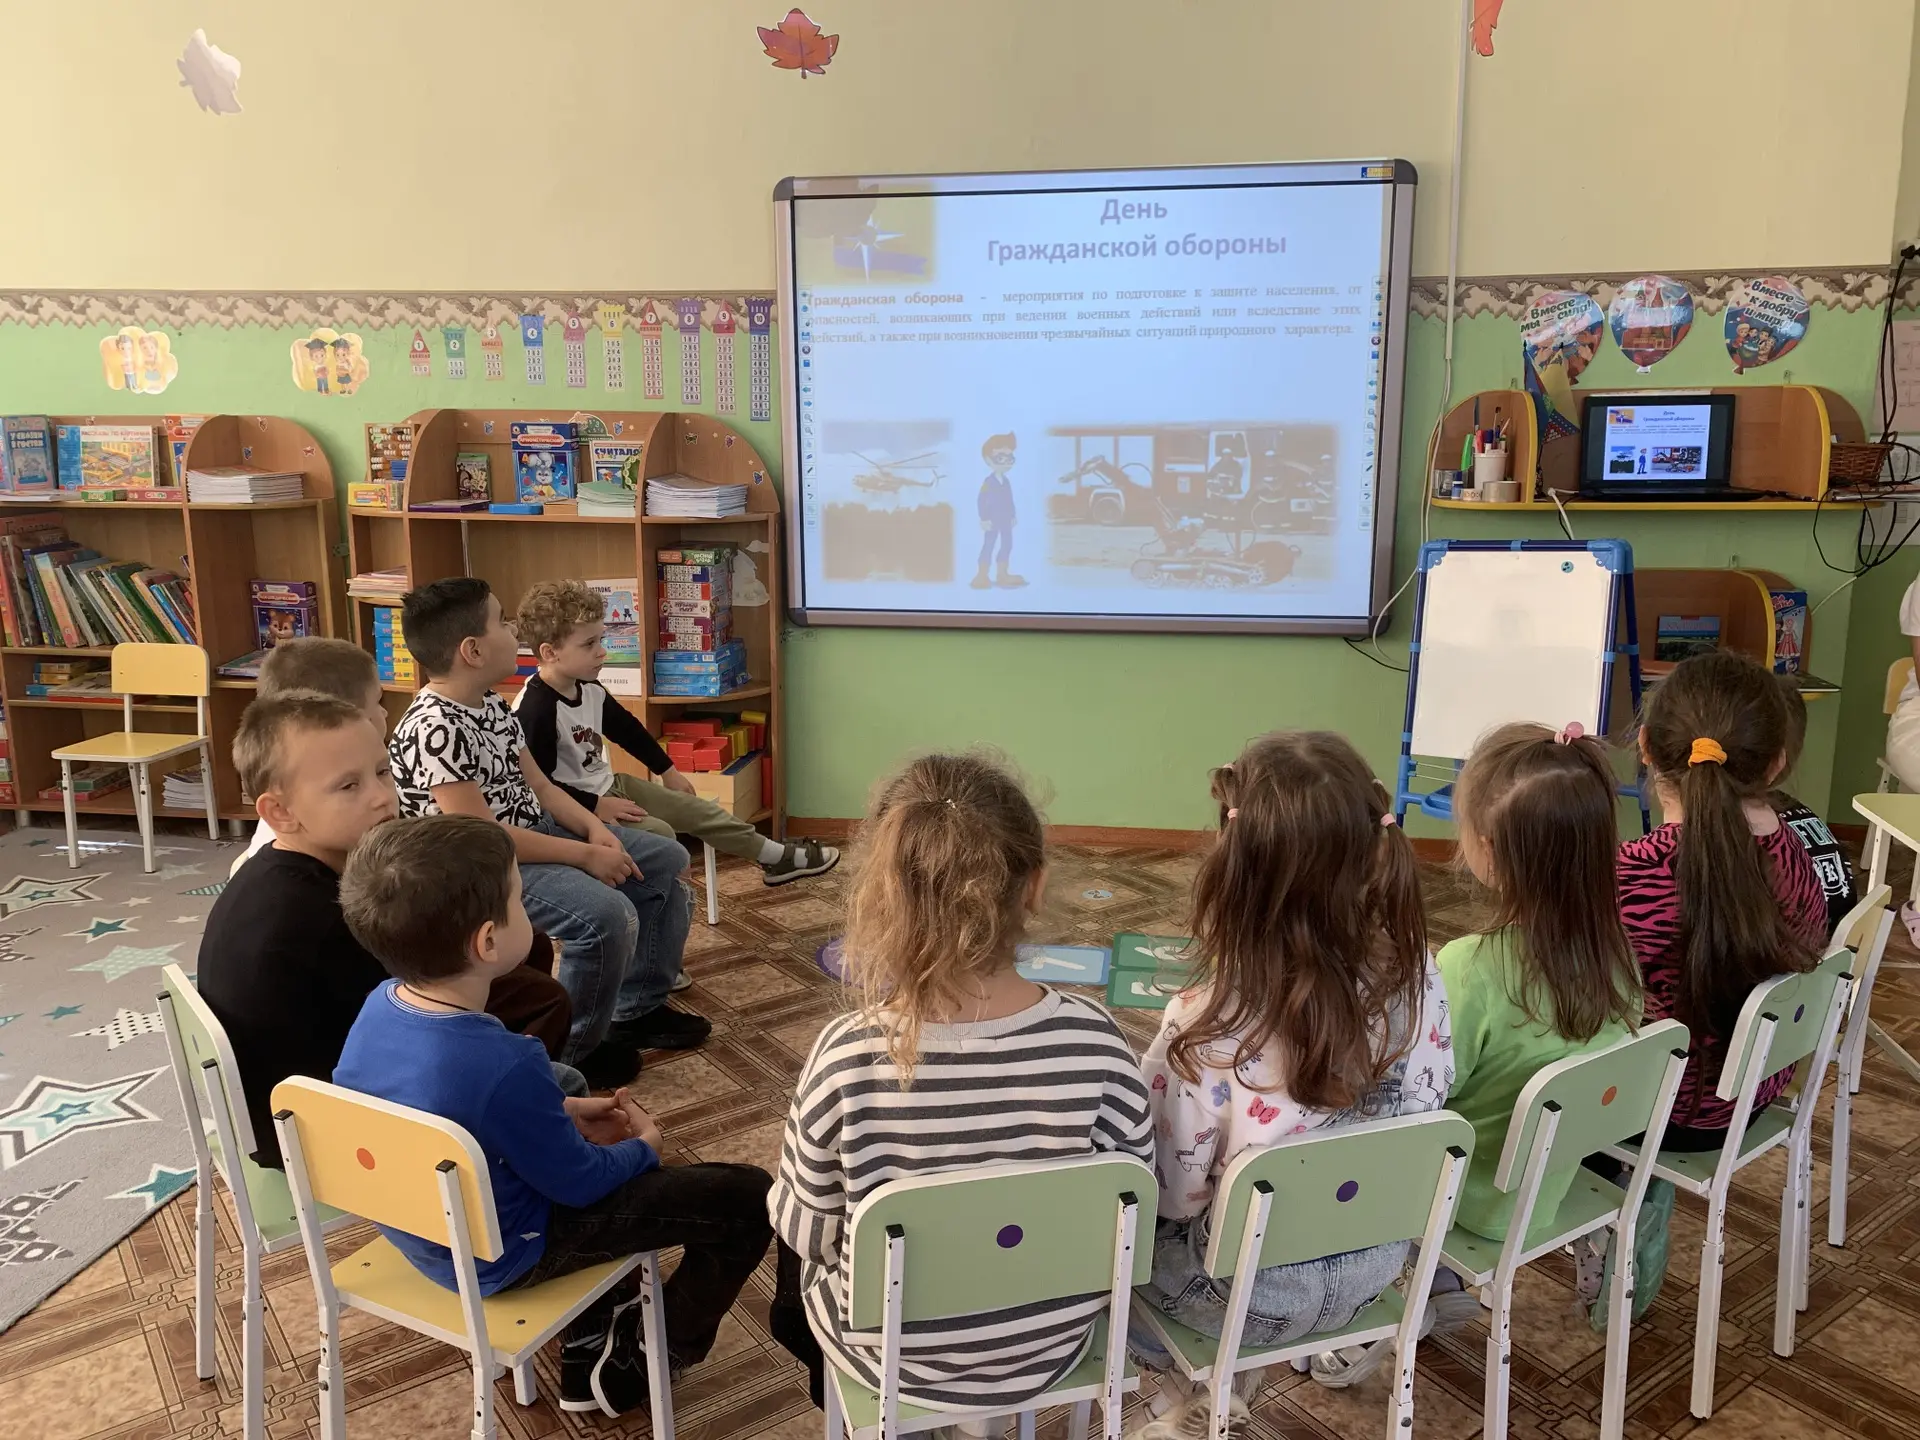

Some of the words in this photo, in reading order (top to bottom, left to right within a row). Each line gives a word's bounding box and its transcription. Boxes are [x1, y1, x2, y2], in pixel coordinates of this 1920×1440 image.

[1100, 197, 1168, 225] День
[988, 235, 1157, 265] Гражданской
[1165, 233, 1287, 261] обороны
[904, 292, 964, 305] оборона
[1002, 291, 1084, 305] мероприятия
[1092, 290, 1108, 301] по
[1116, 288, 1187, 302] подготовке
[1210, 287, 1258, 300] защите
[1348, 285, 1363, 296] от
[1750, 280, 1794, 303] Вместе
[982, 312, 1006, 325] при
[1016, 310, 1067, 322] ведении
[1077, 308, 1131, 320] военных
[1140, 306, 1201, 321] действий
[1212, 306, 1237, 318] или
[1247, 305, 1321, 317] вследствие
[1331, 304, 1363, 316] этих
[1520, 320, 1541, 333] мы
[1557, 299, 1592, 320] сила!
[1530, 298, 1576, 320] Вместе
[1750, 296, 1757, 305] к
[1759, 300, 1799, 320] добру
[880, 332, 916, 344] также
[918, 331, 941, 344] при
[944, 328, 1038, 342] возникновении
[1041, 325, 1131, 341] чрезвычайных
[1136, 324, 1198, 340] ситуаций
[1200, 323, 1276, 339] природного
